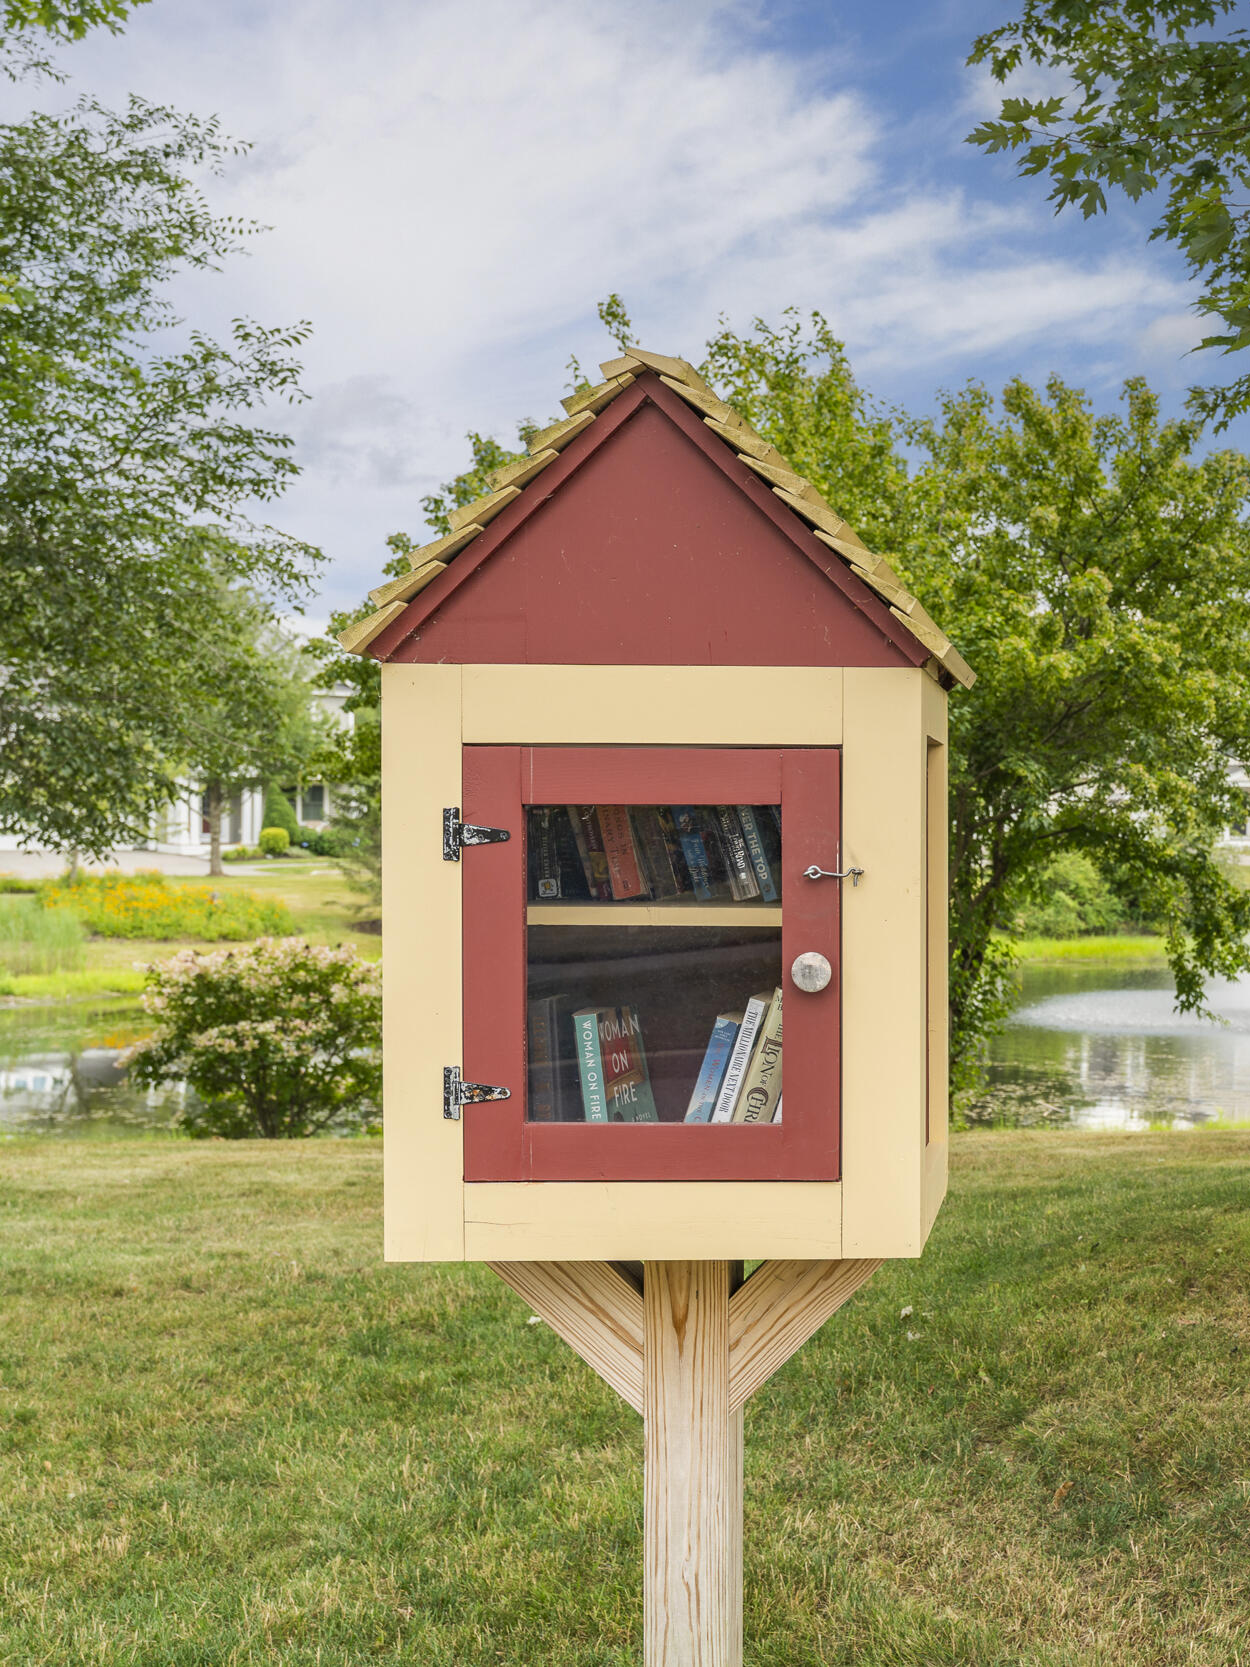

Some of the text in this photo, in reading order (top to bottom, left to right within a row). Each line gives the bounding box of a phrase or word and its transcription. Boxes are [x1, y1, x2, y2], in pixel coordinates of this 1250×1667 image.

[739, 805, 768, 880] VER THE TOP
[599, 1014, 640, 1041] WOMAN
[582, 1020, 602, 1119] WOMAN ON FIRE
[612, 1050, 628, 1073] ON
[719, 1010, 758, 1113] THE MILLIONAIRE NEXT DOOR
[761, 1036, 783, 1077] LION
[613, 1081, 638, 1108] FIRE
